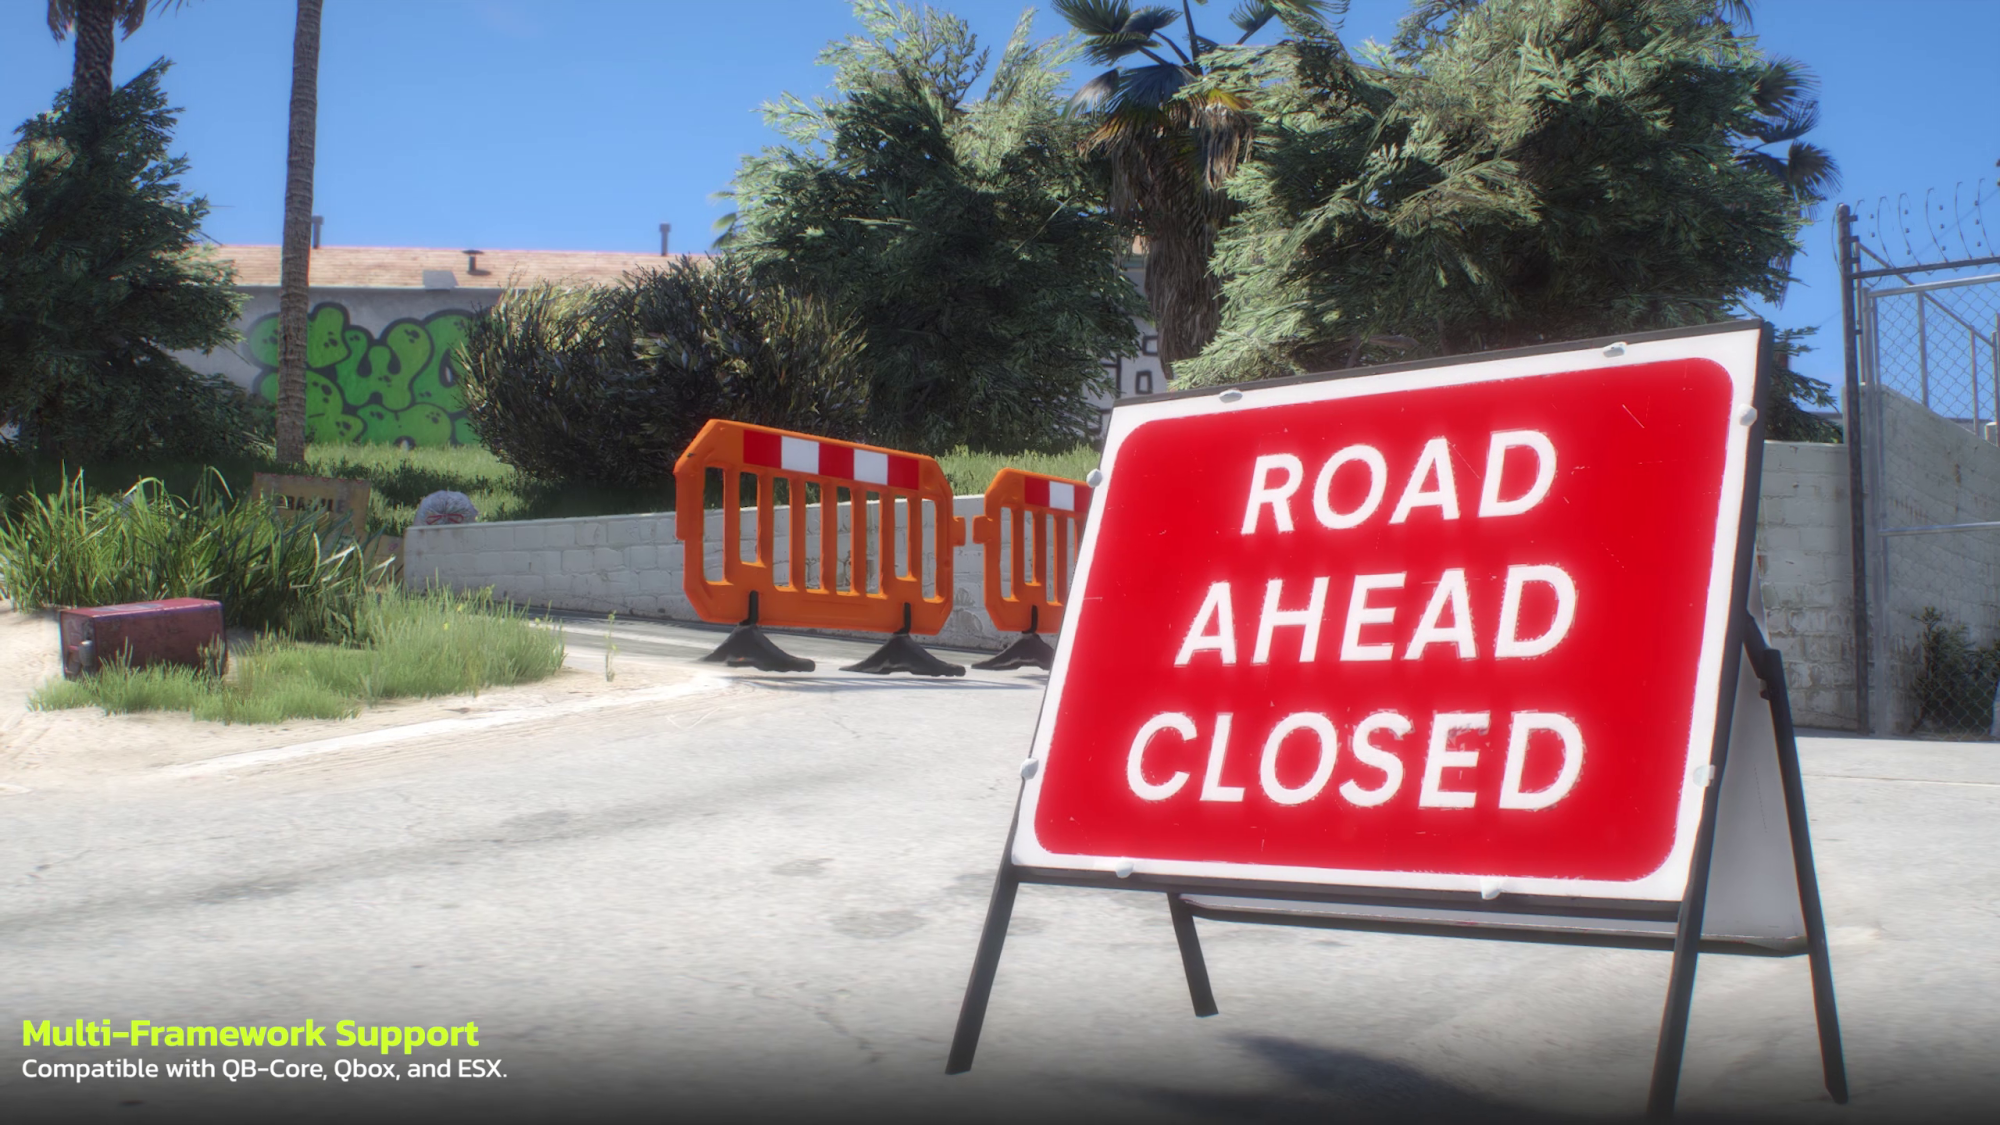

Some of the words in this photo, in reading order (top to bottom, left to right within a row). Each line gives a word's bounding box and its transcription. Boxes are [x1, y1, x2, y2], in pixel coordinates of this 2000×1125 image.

[1241, 430, 1556, 534] ROAD
[1175, 564, 1578, 666] AHEAD
[1126, 710, 1585, 811] CLOSED
